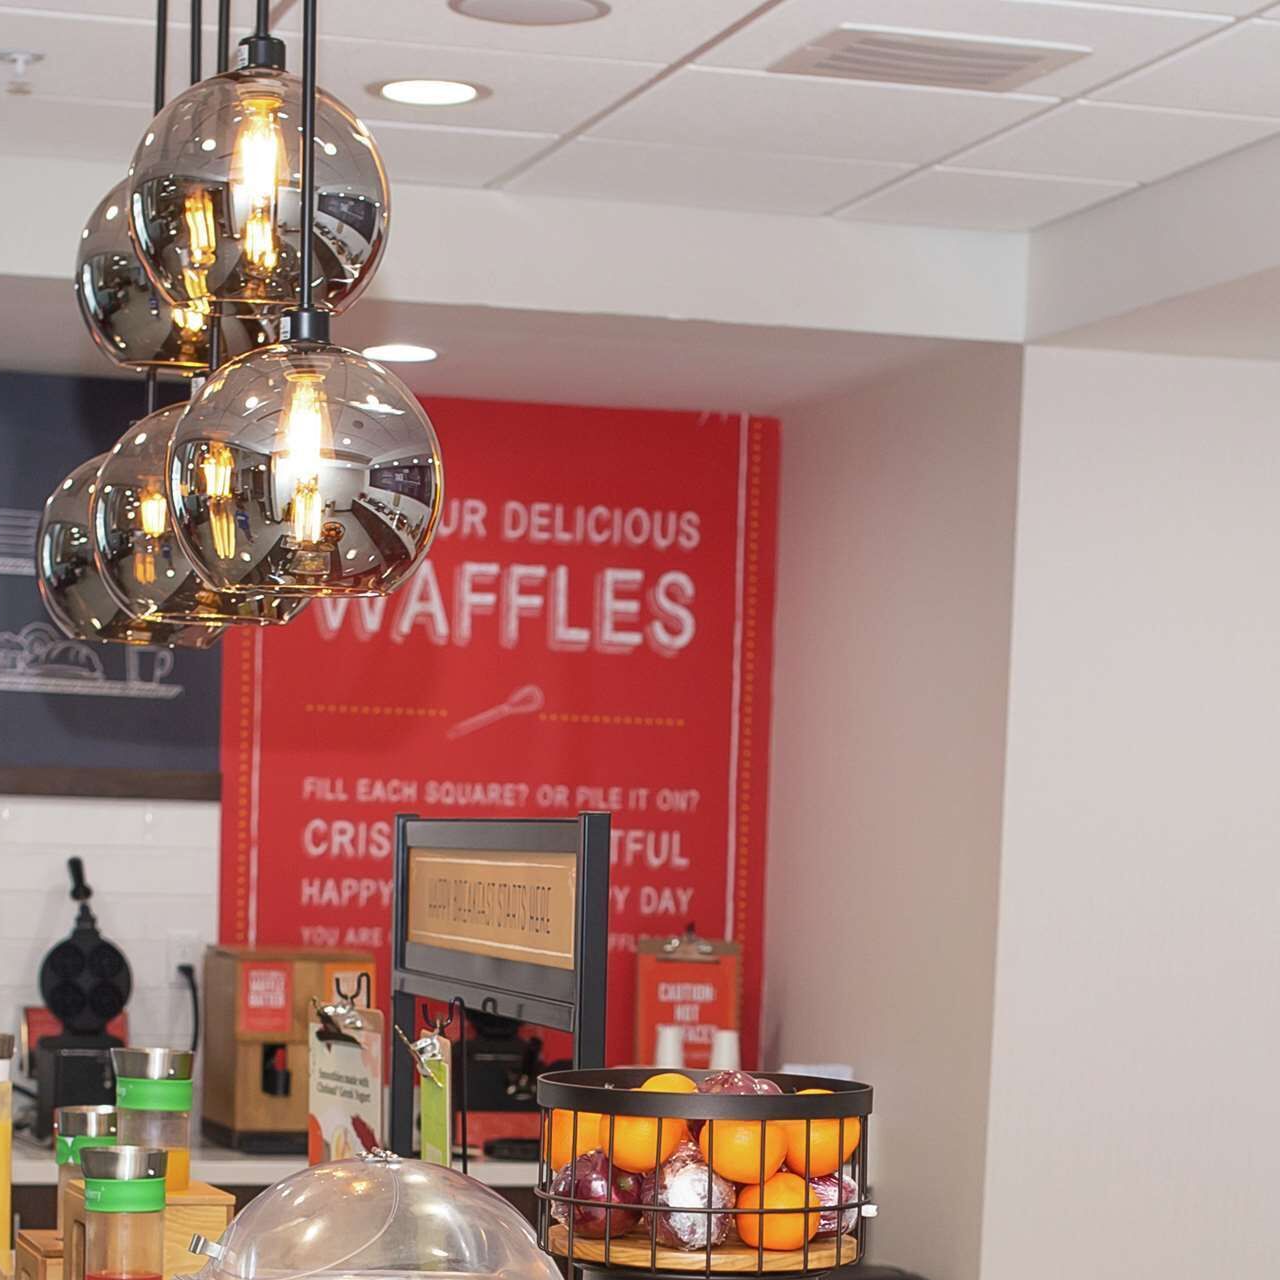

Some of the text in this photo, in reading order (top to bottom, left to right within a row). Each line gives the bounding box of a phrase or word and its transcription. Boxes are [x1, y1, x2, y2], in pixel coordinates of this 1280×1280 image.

[436, 498, 701, 551] UR DELICIOUS
[302, 777, 700, 813] FILL EACH SQUARE? OR PILE IT ON?
[303, 818, 392, 859] CRIS
[300, 878, 394, 907] HAPPY
[639, 886, 695, 916] DAY
